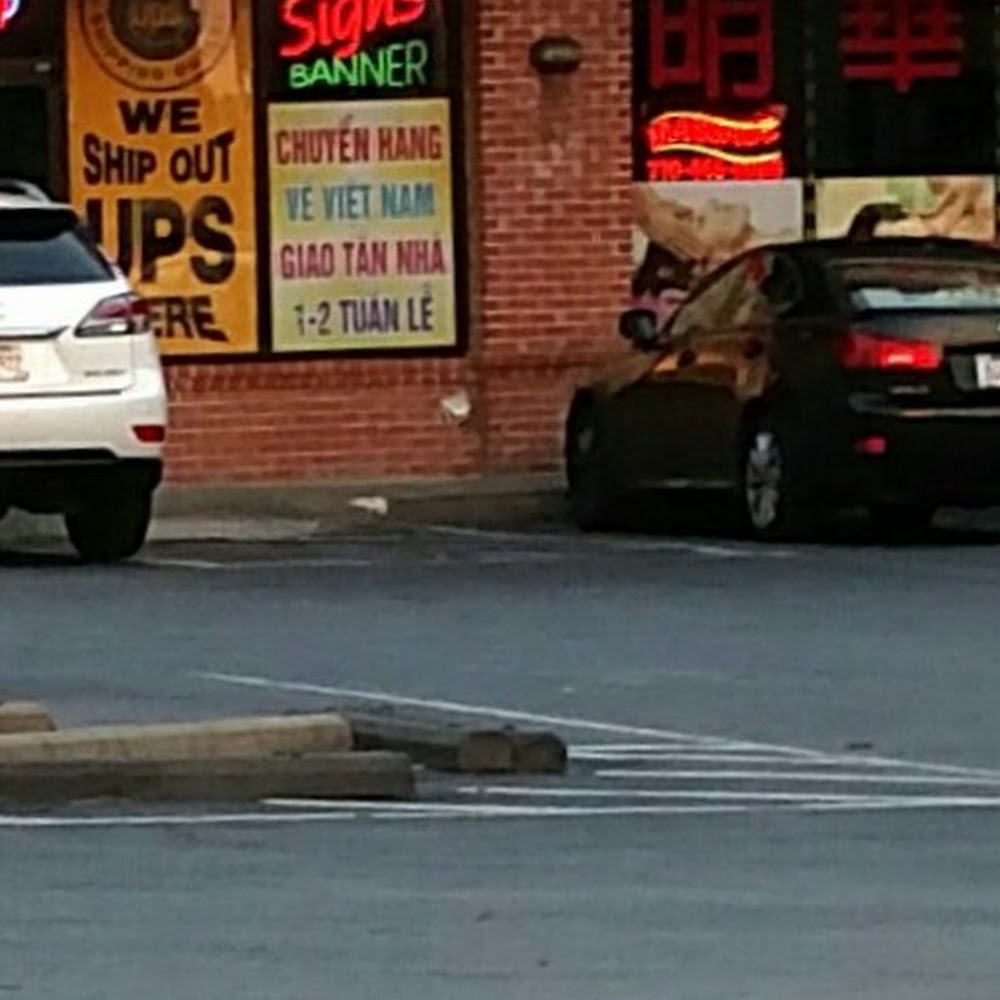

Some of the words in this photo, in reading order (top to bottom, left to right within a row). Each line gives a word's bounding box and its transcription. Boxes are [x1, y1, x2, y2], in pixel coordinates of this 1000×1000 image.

[288, 39, 428, 89] BANNER
[117, 98, 202, 134] WE
[83, 132, 158, 186] SHIP
[169, 130, 236, 184] OUT
[382, 183, 435, 218] NAM
[280, 242, 335, 280] GIAO
[147, 295, 230, 342] ERE
[294, 301, 331, 336] 1-2
